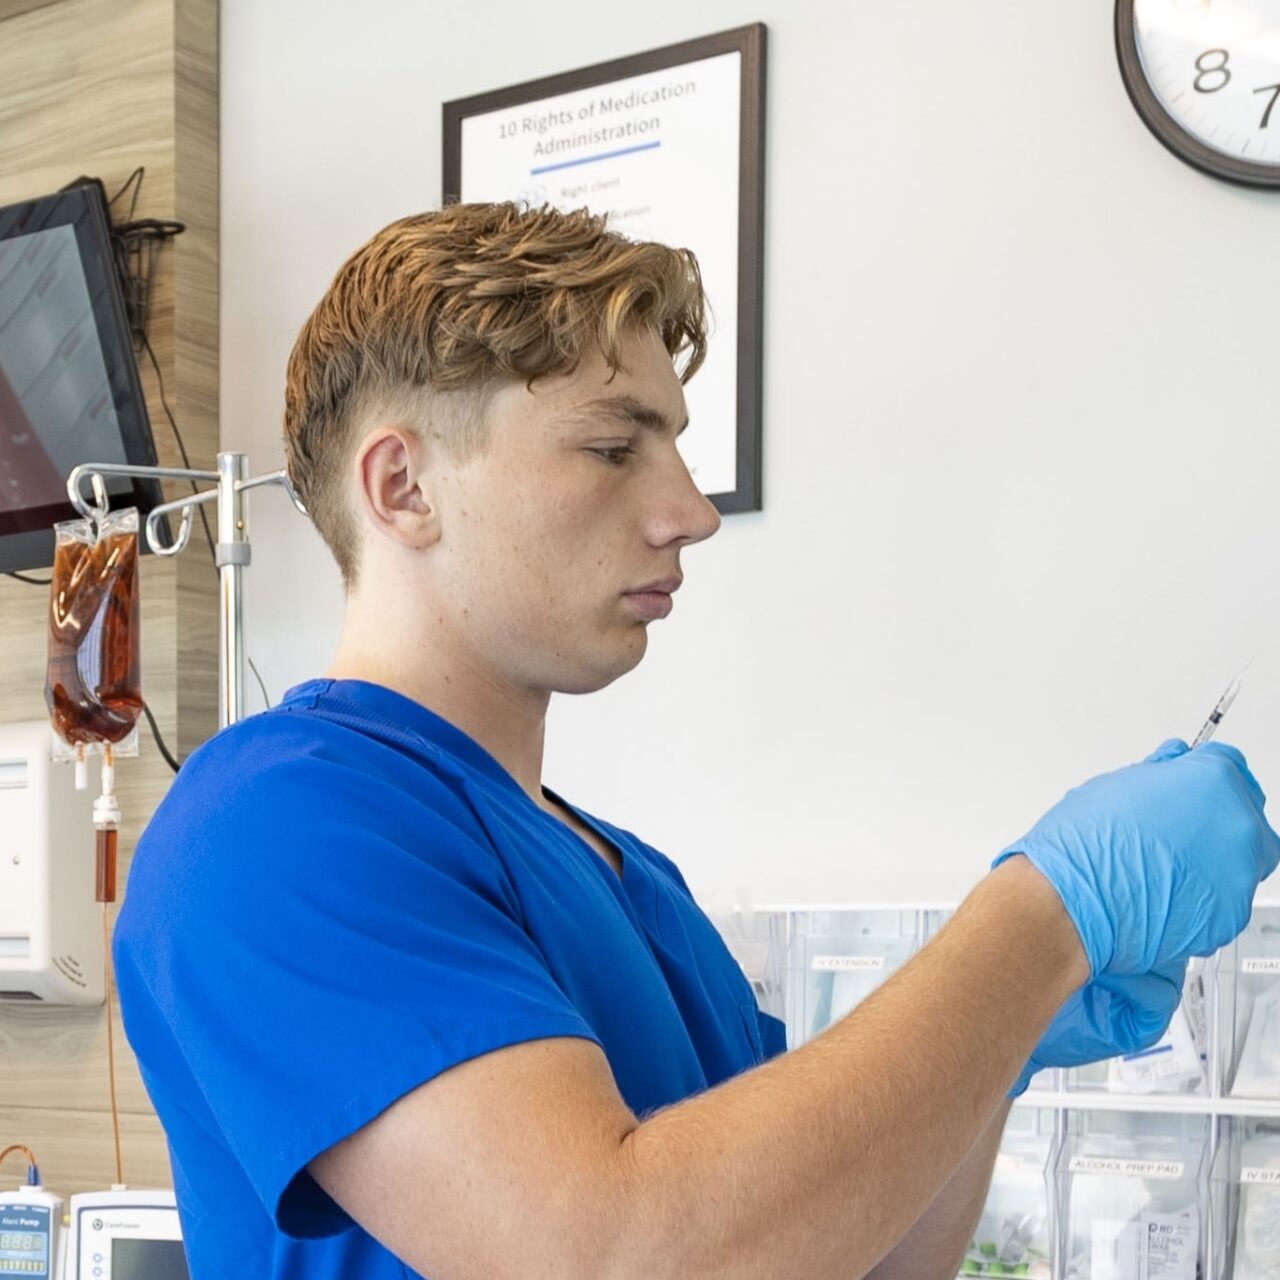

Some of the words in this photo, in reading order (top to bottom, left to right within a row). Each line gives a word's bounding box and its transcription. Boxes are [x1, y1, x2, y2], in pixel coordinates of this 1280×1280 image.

[1192, 48, 1232, 94] 8
[498, 121, 518, 140] 10
[522, 110, 574, 134] Rights
[578, 101, 596, 121] of
[599, 80, 697, 116] Medication
[1252, 83, 1280, 130] 7
[533, 116, 661, 157] Administration
[1074, 1160, 1121, 1171] ALCOHOL
[1125, 1162, 1155, 1172] PREP
[1156, 1164, 1179, 1174] PAD
